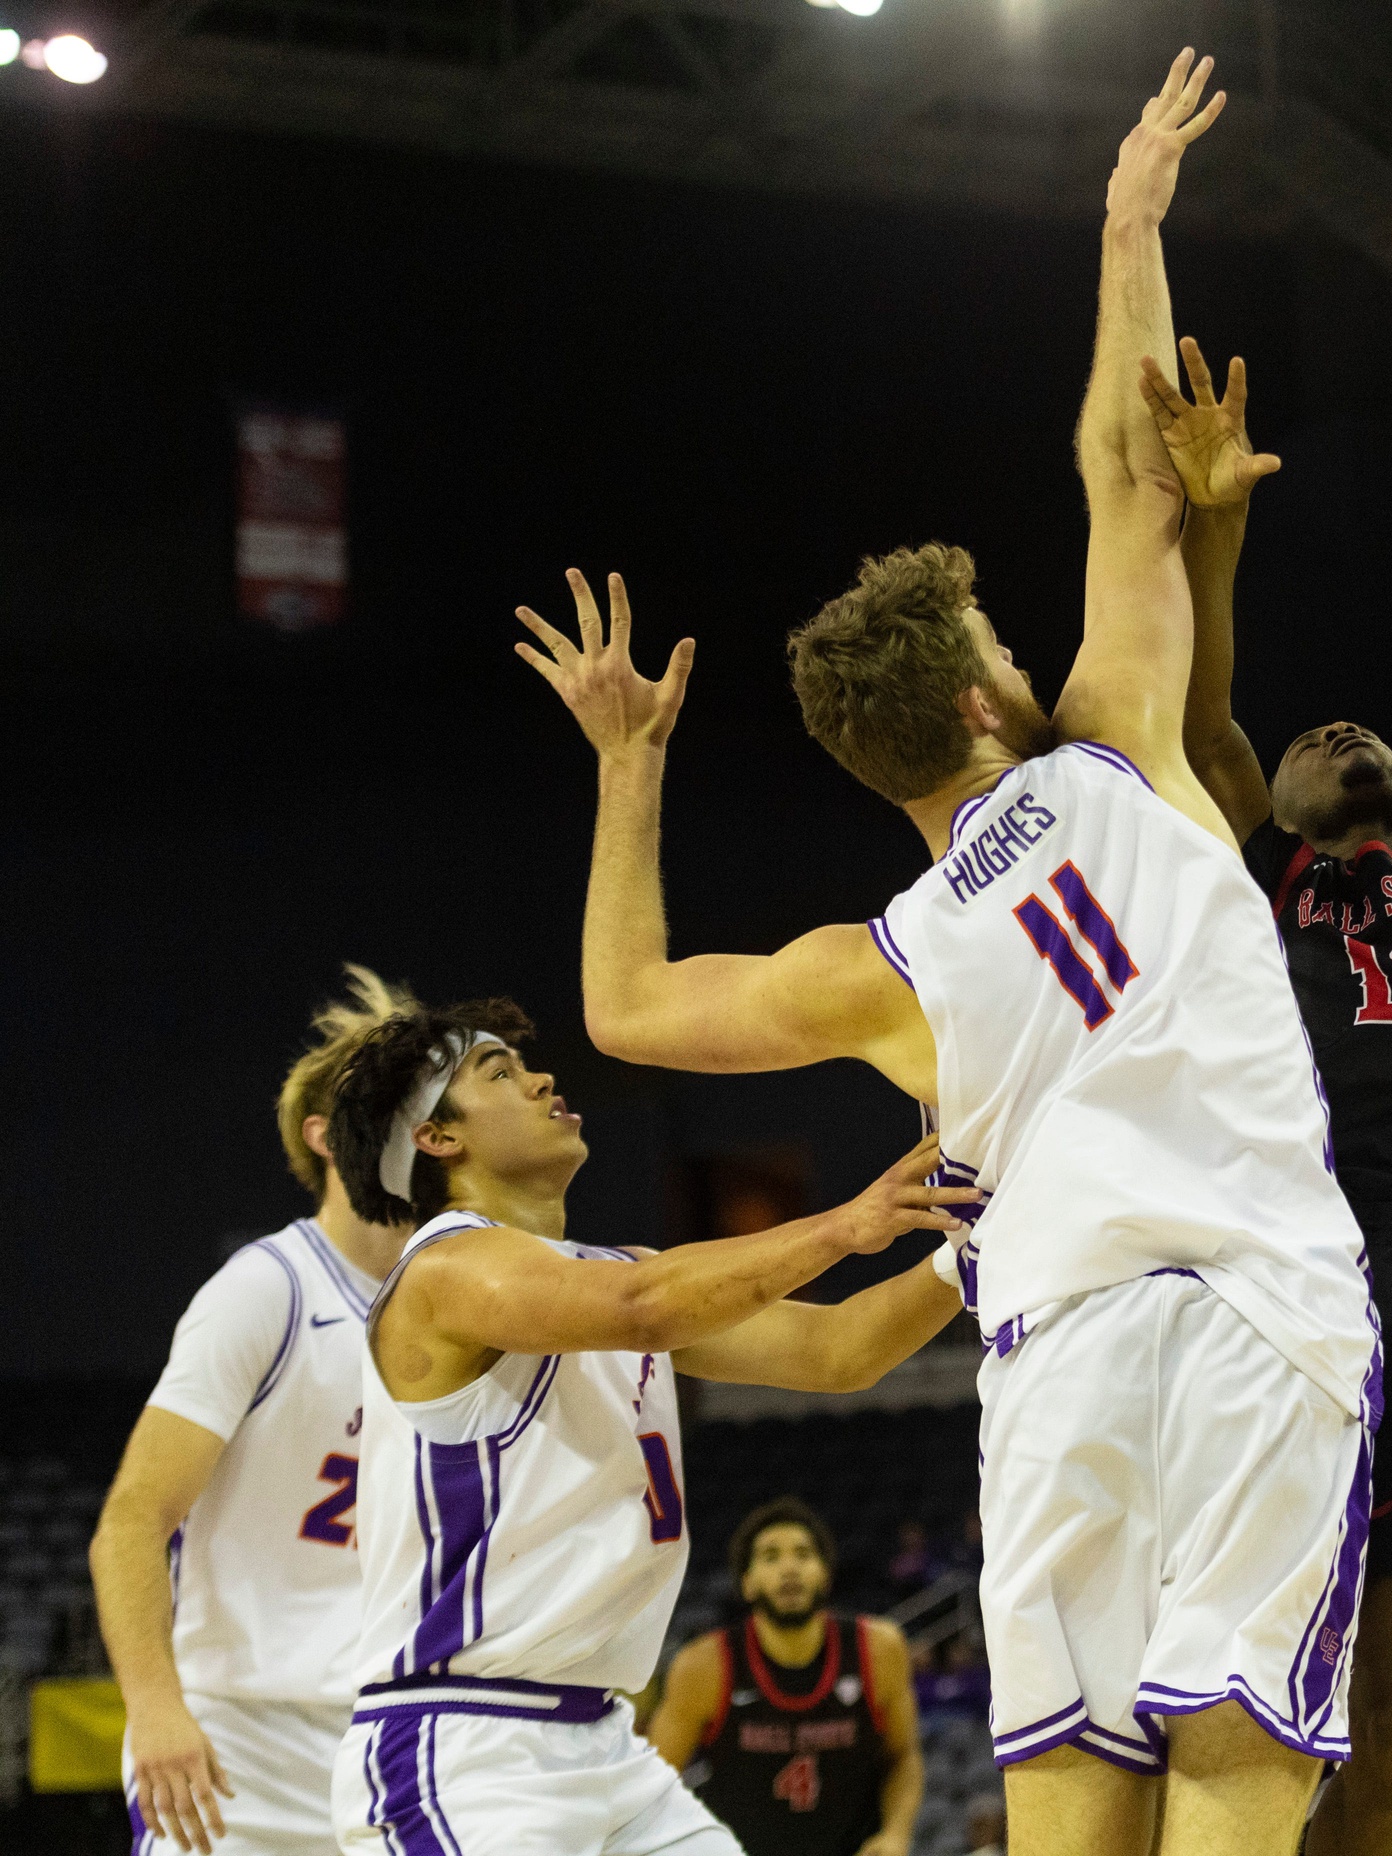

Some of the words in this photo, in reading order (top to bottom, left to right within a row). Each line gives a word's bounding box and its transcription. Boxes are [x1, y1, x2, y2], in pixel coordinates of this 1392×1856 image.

[942, 792, 1057, 905] HUGHES
[1011, 858, 1141, 1033] 11
[1298, 888, 1376, 935] BALL
[297, 1452, 358, 1551] 2
[773, 1754, 820, 1813] 4
